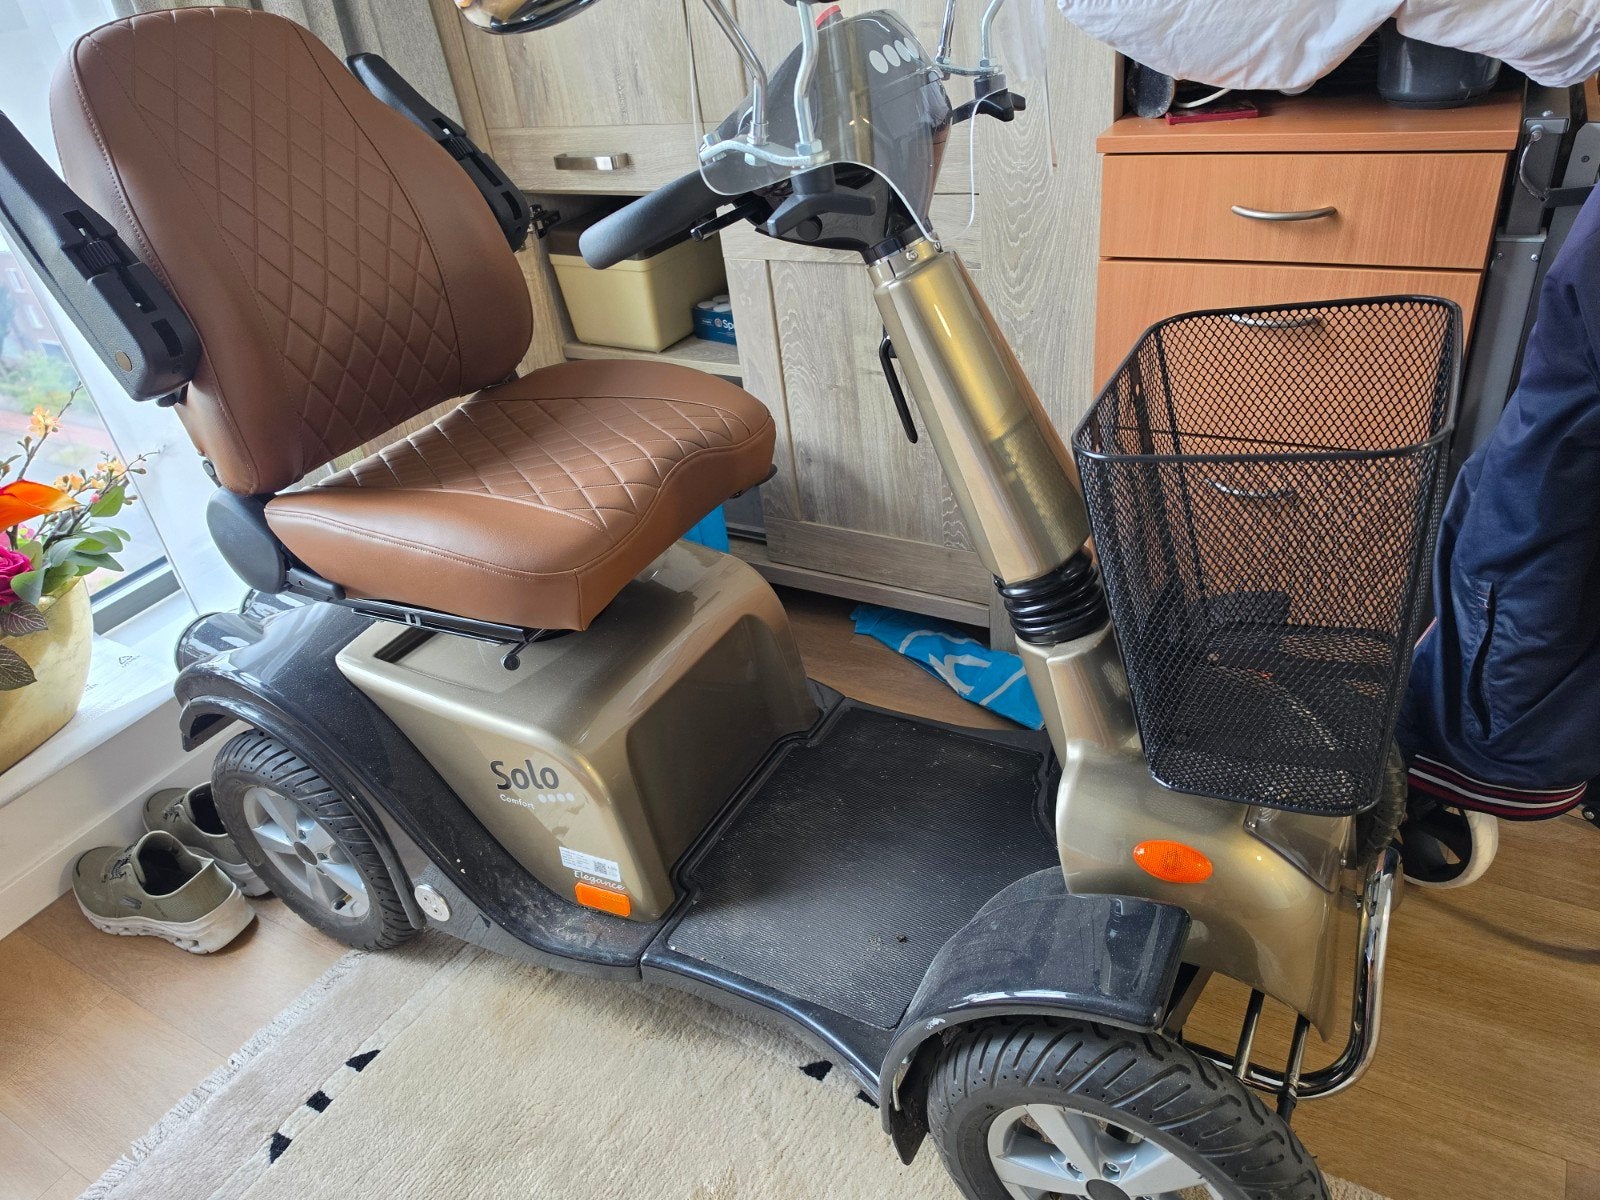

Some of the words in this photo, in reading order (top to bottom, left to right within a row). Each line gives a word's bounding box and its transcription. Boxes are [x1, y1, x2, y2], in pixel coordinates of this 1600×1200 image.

[490, 760, 559, 790] Solo
[500, 794, 536, 810] Comfort
[574, 870, 625, 891] Elegance
